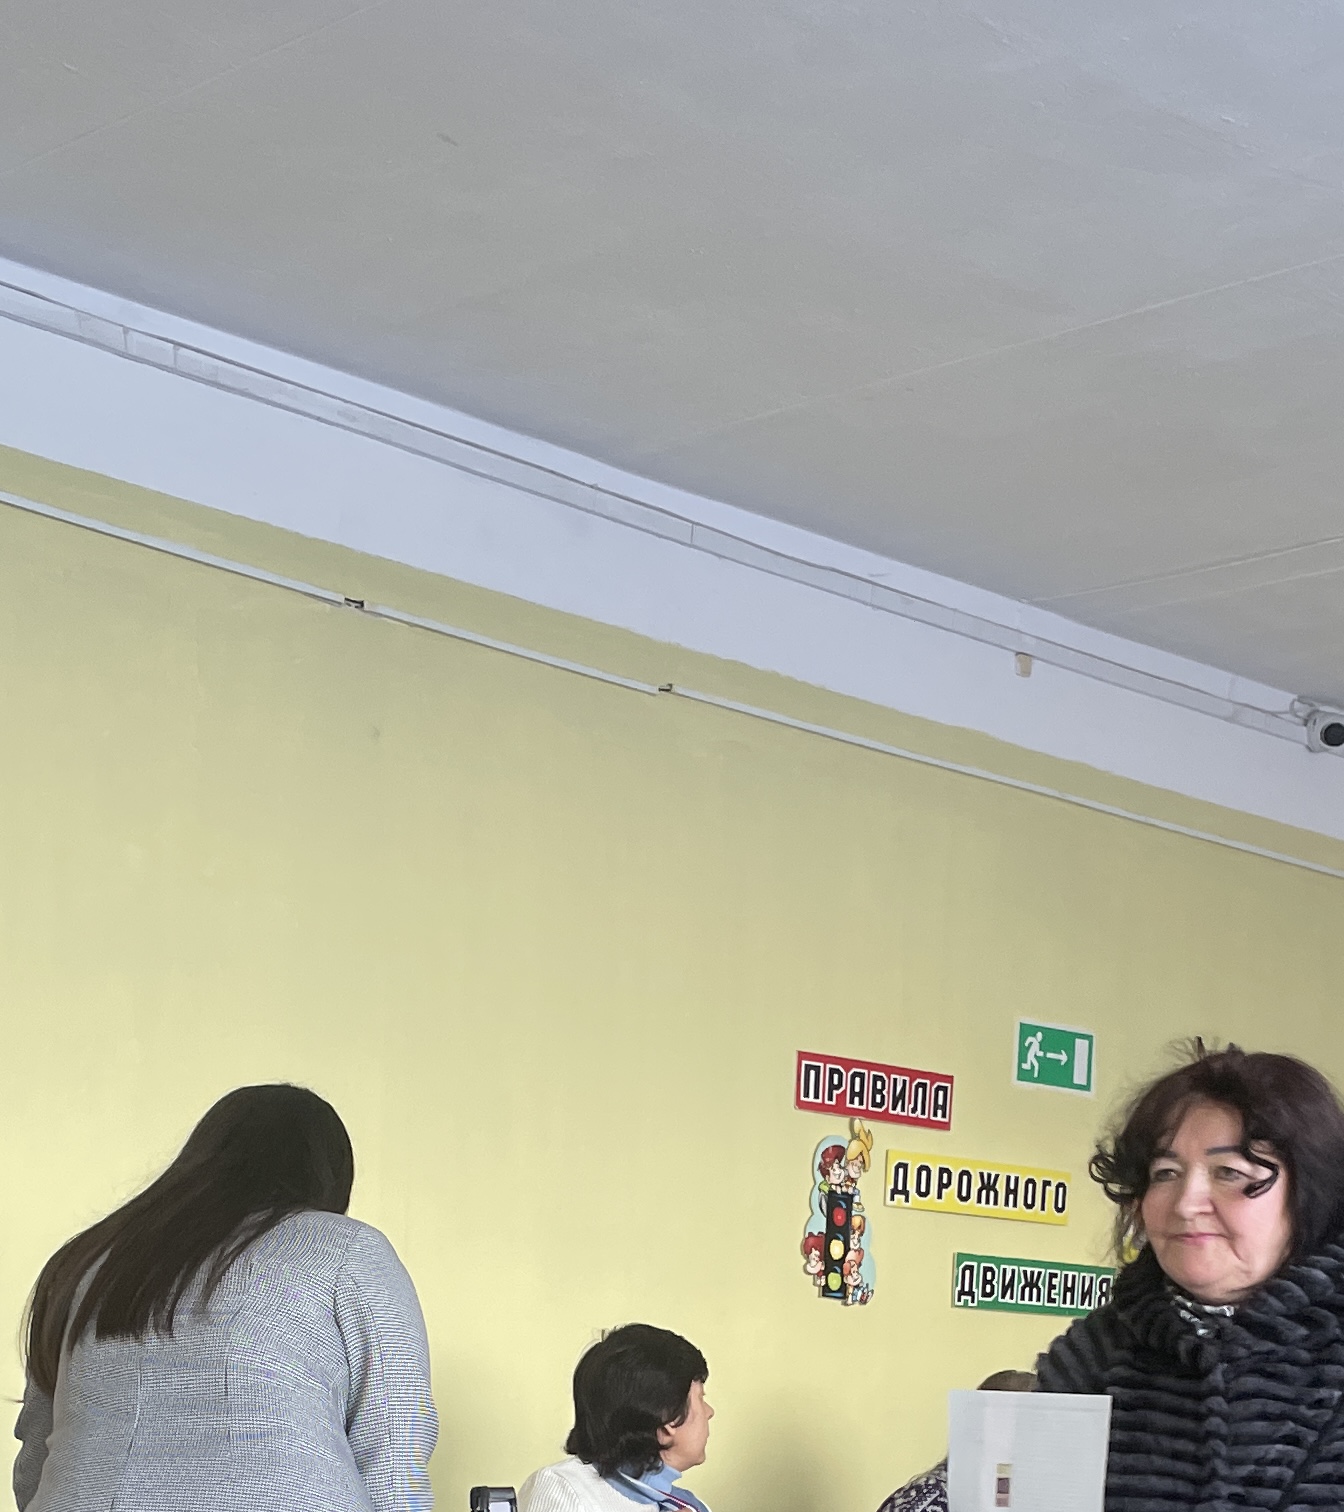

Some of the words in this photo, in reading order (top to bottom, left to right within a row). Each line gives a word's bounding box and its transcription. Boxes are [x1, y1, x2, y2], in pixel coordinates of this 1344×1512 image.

[801, 1061, 950, 1121] ПРАВИЛА
[889, 1161, 1068, 1214] ДОРОЖНОГО
[956, 1263, 1112, 1309] ДВИЖЕНИЯ
